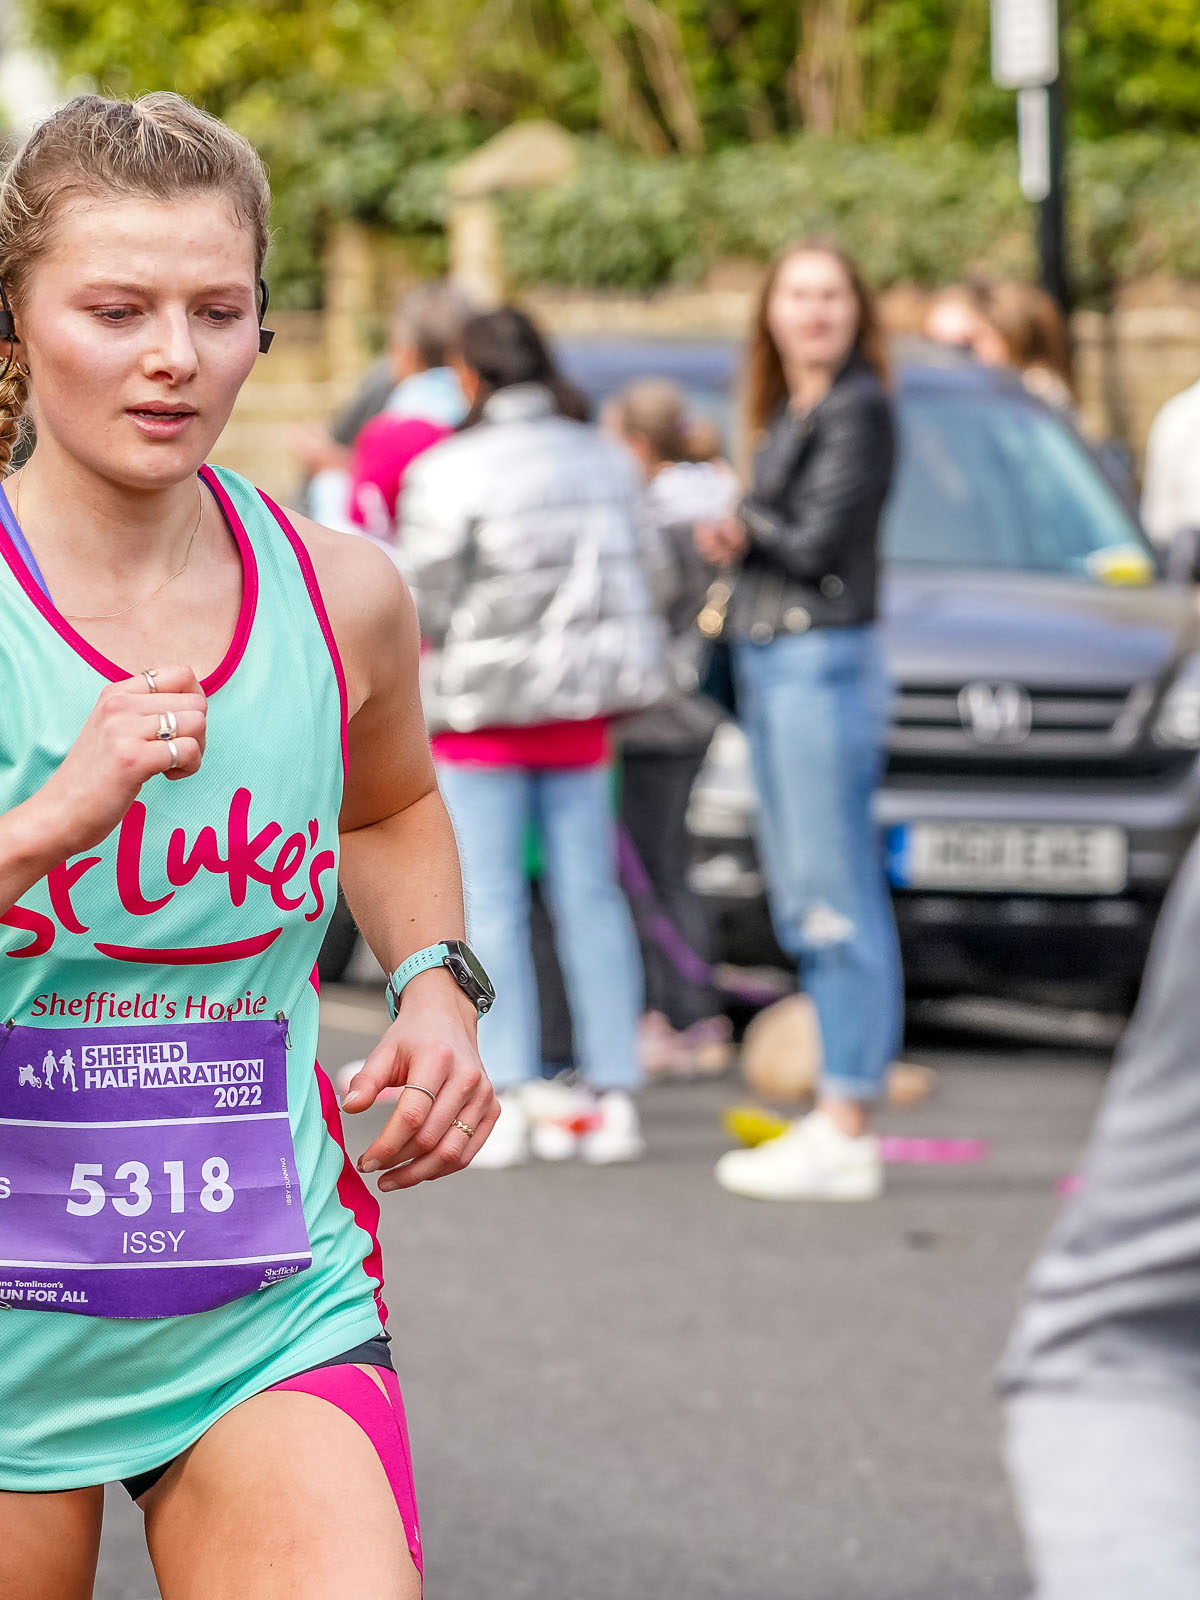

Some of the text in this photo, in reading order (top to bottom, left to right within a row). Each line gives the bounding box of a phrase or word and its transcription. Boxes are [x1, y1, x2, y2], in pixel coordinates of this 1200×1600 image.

[116, 787, 335, 922] Luke's
[31, 991, 176, 1023] Sheffield's
[84, 1044, 184, 1066] SHEFFIELD
[84, 1062, 262, 1089] HALF MARATHON
[213, 1085, 262, 1108] 2022
[65, 1156, 235, 1217] 5318
[122, 1229, 186, 1254] ISSY
[15, 1280, 64, 1289] Tomlinson's
[26, 1290, 57, 1302] FOR
[60, 1291, 88, 1303] ALL
